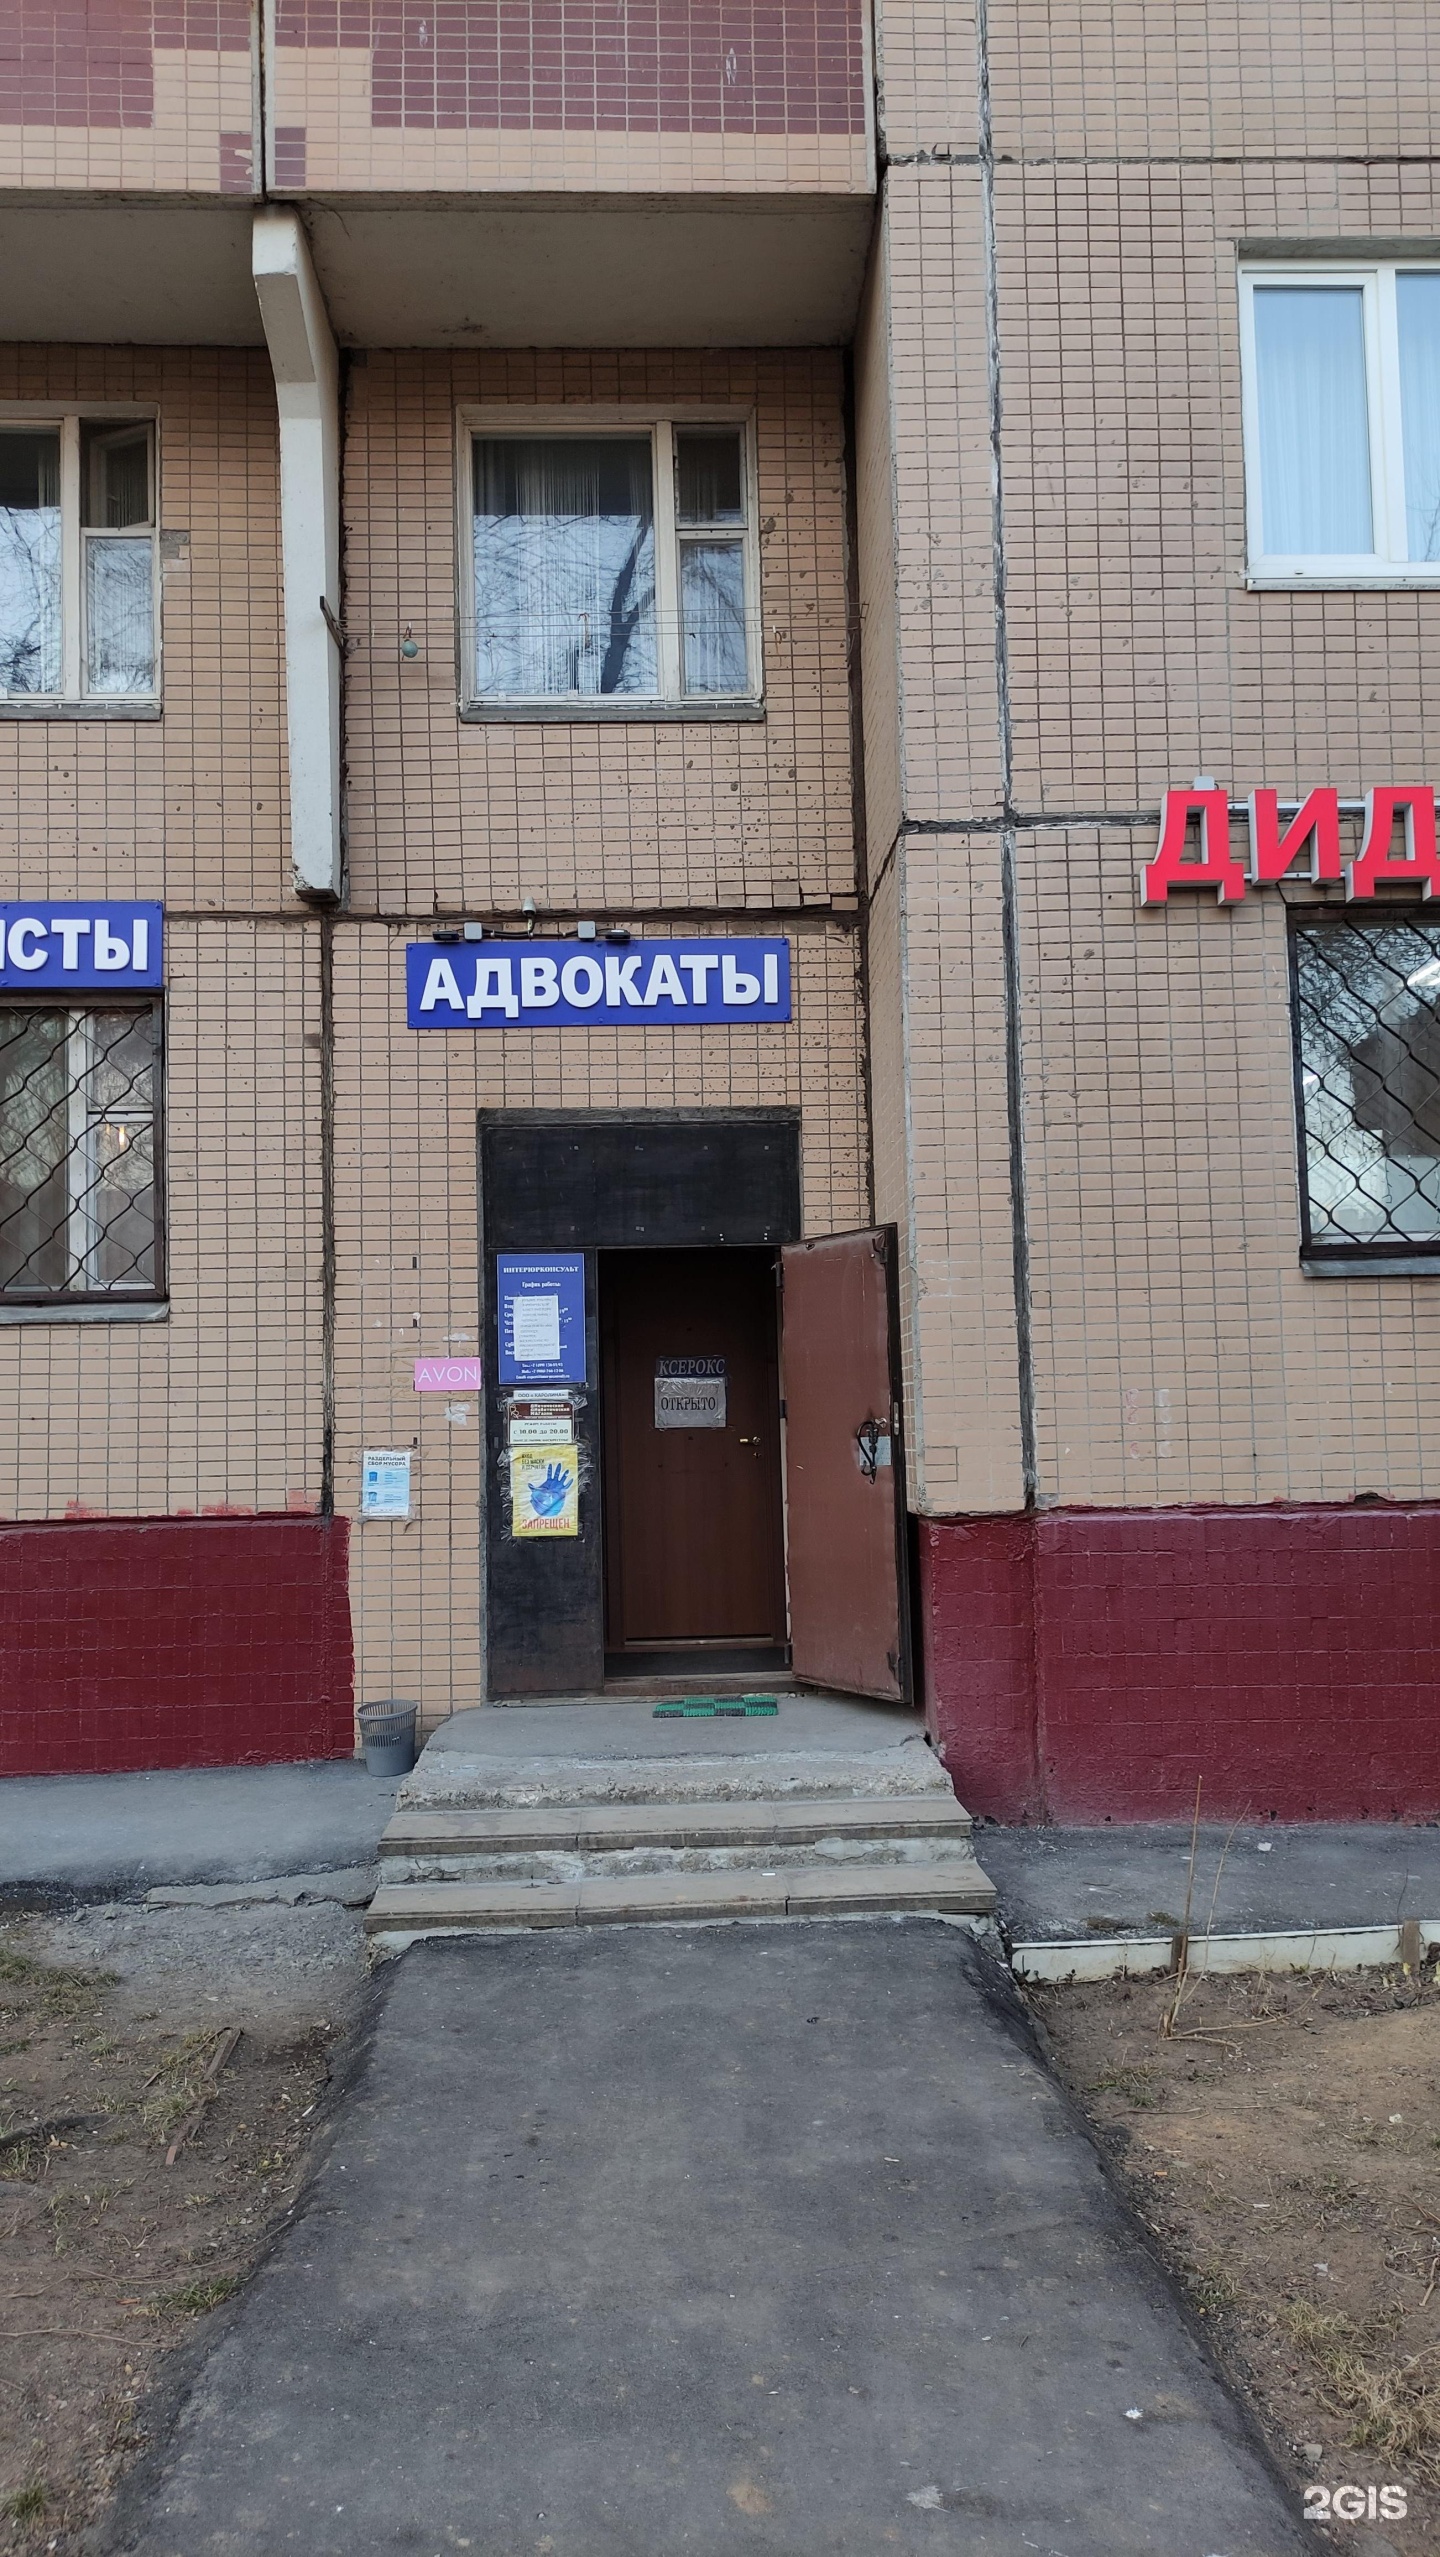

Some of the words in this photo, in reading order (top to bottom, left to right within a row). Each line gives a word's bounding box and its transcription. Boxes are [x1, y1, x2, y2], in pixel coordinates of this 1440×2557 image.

[0, 917, 149, 972] СТЫ
[419, 953, 779, 1019] АДВОКАТЫ
[418, 1366, 478, 1383] AVON
[658, 1359, 726, 1376] КСЕРОКС
[660, 1396, 716, 1411] ОТКРЫТО
[521, 1517, 570, 1530] ЗАПРЕЩЕН
